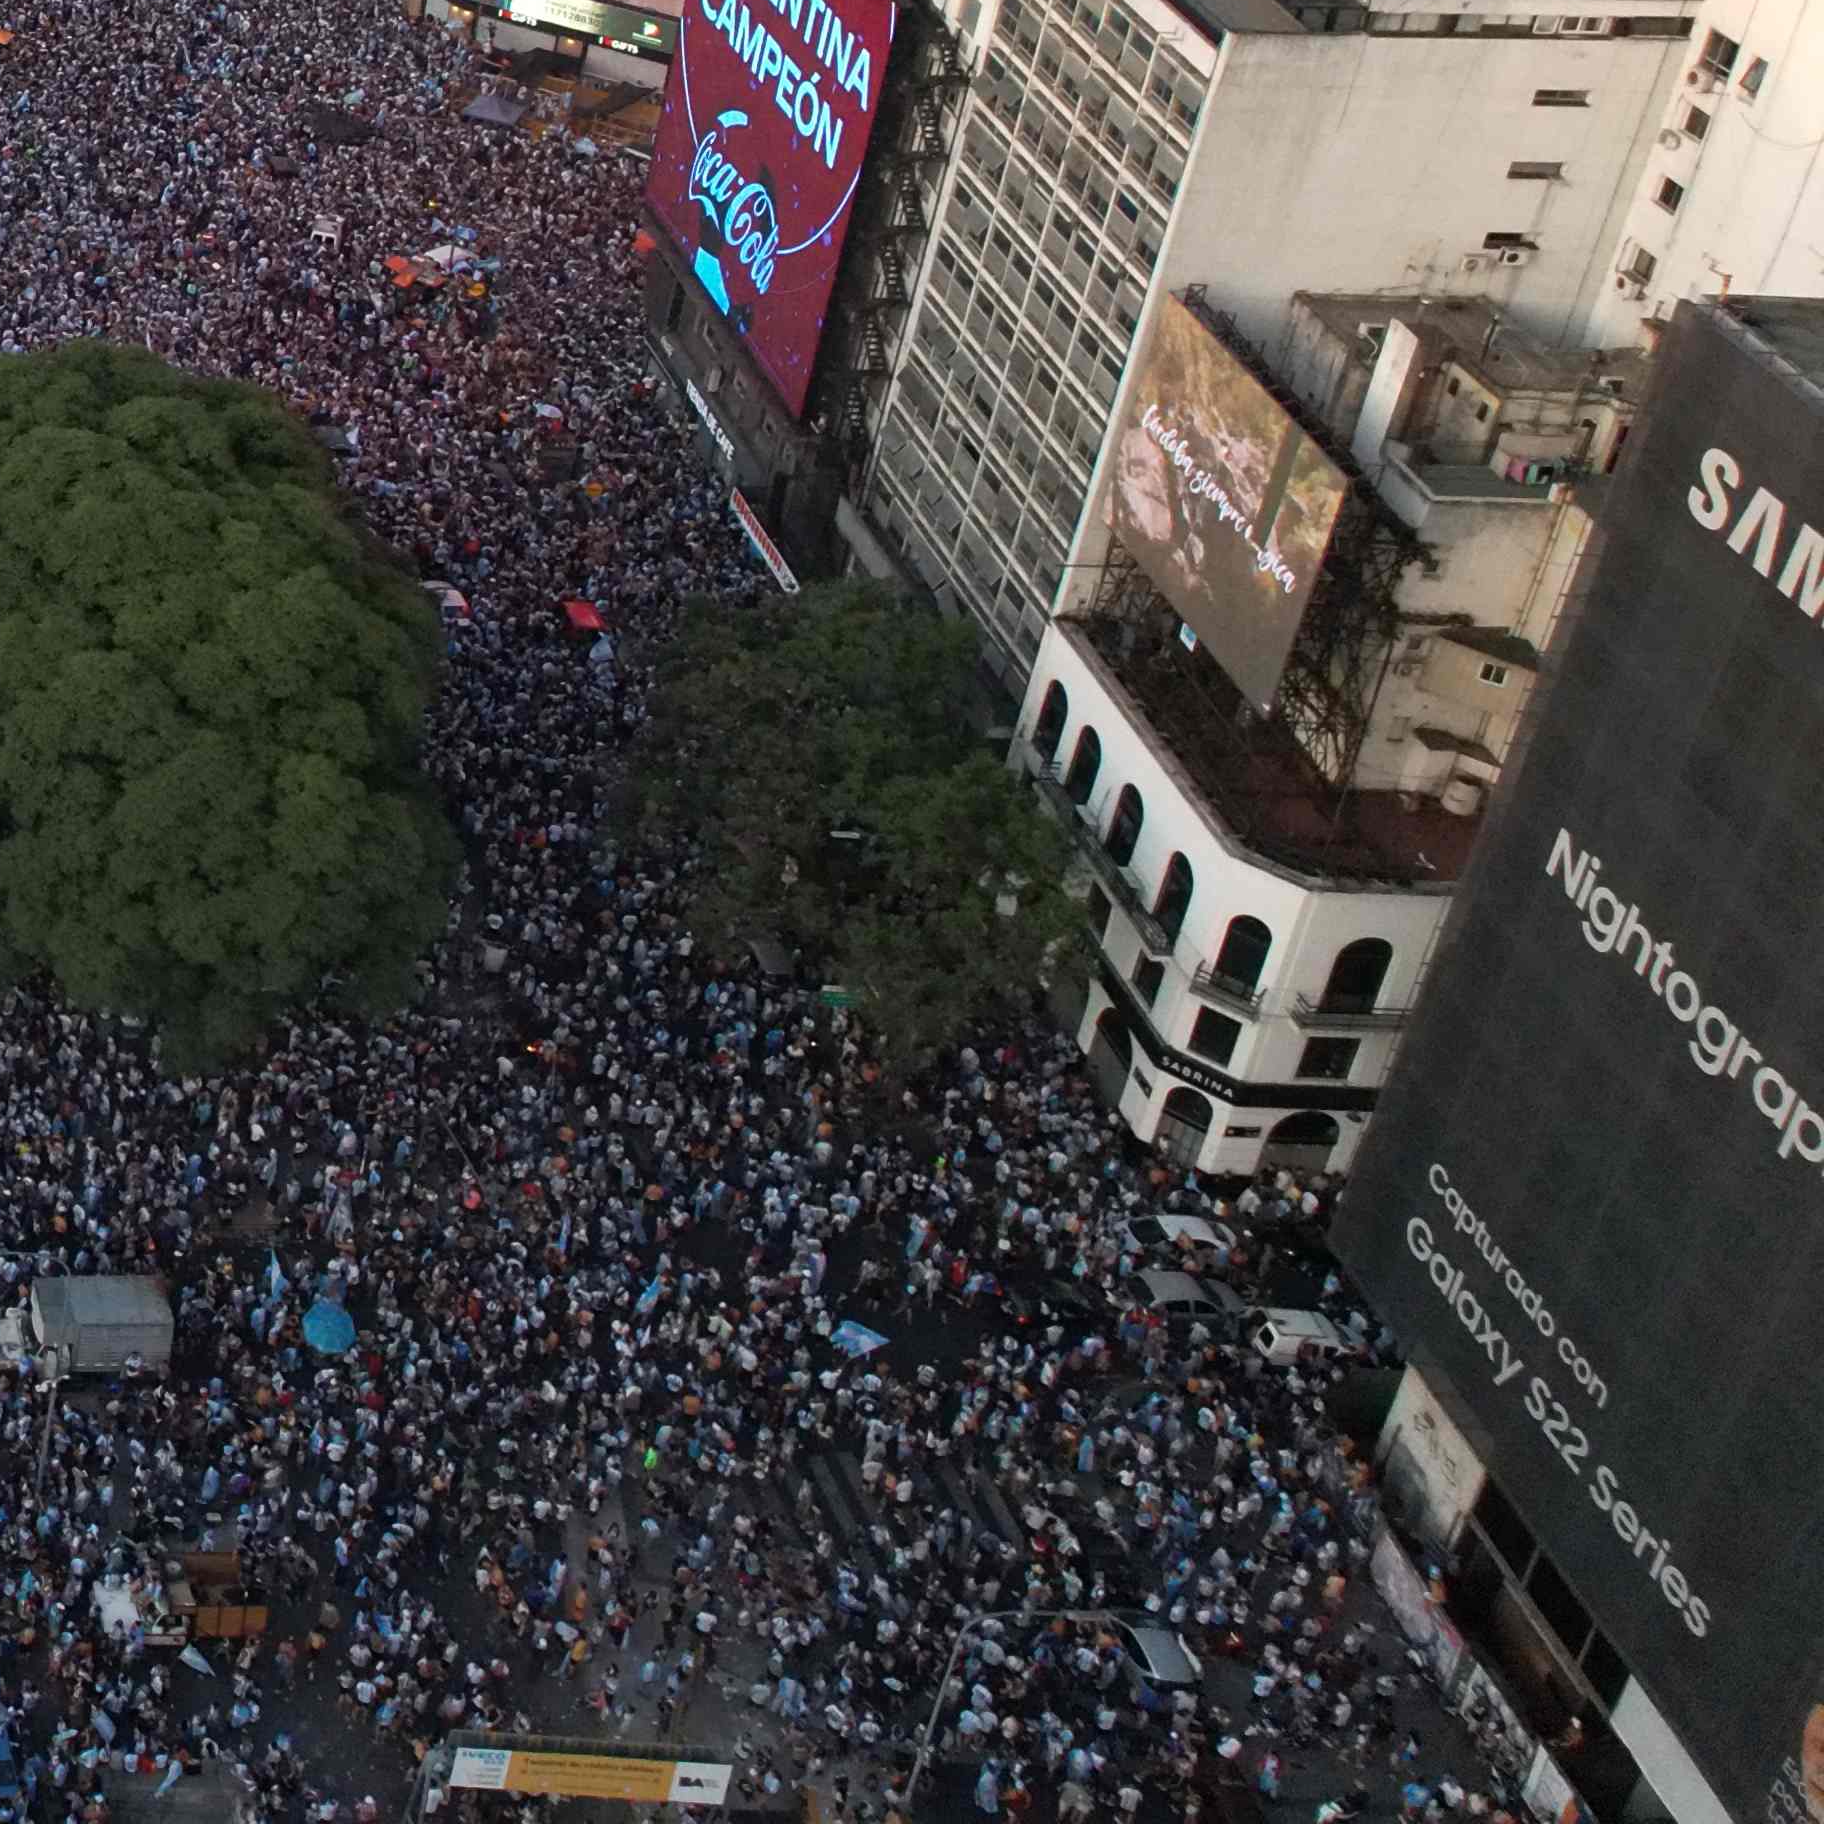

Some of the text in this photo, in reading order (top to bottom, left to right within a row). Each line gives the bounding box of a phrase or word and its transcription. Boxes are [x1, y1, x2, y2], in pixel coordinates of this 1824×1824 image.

[611, 40, 639, 55] GIFTS
[1429, 1163, 1554, 1337] Capturado
[1558, 1336, 1609, 1409] con
[1406, 1216, 1712, 1639] Galaxy S22 Series
